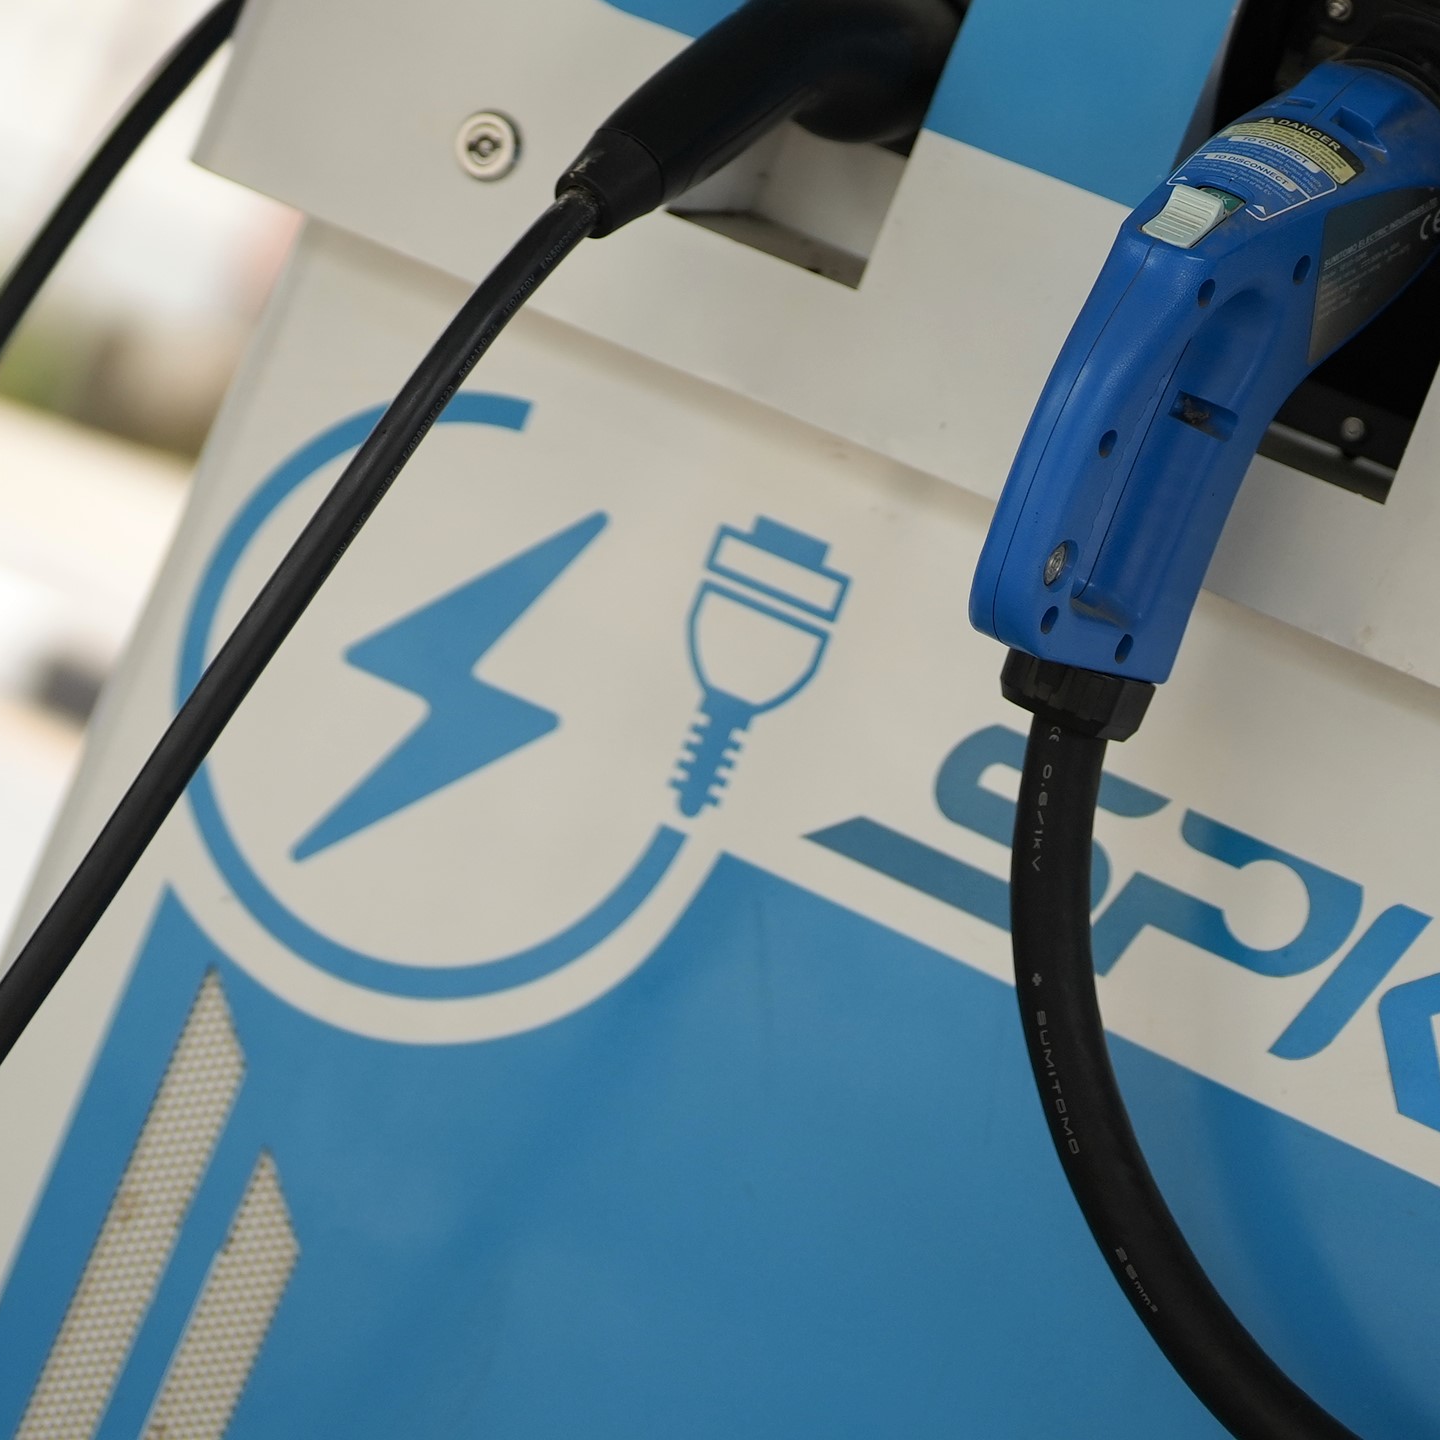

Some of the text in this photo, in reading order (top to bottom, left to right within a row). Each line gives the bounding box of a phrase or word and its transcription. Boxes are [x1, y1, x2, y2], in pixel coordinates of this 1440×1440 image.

[1258, 138, 1309, 164] CONNECT
[1277, 118, 1341, 152] DANGER
[1227, 155, 1289, 186] DISCONNECT
[1036, 1009, 1080, 1156] SUMITOMO
